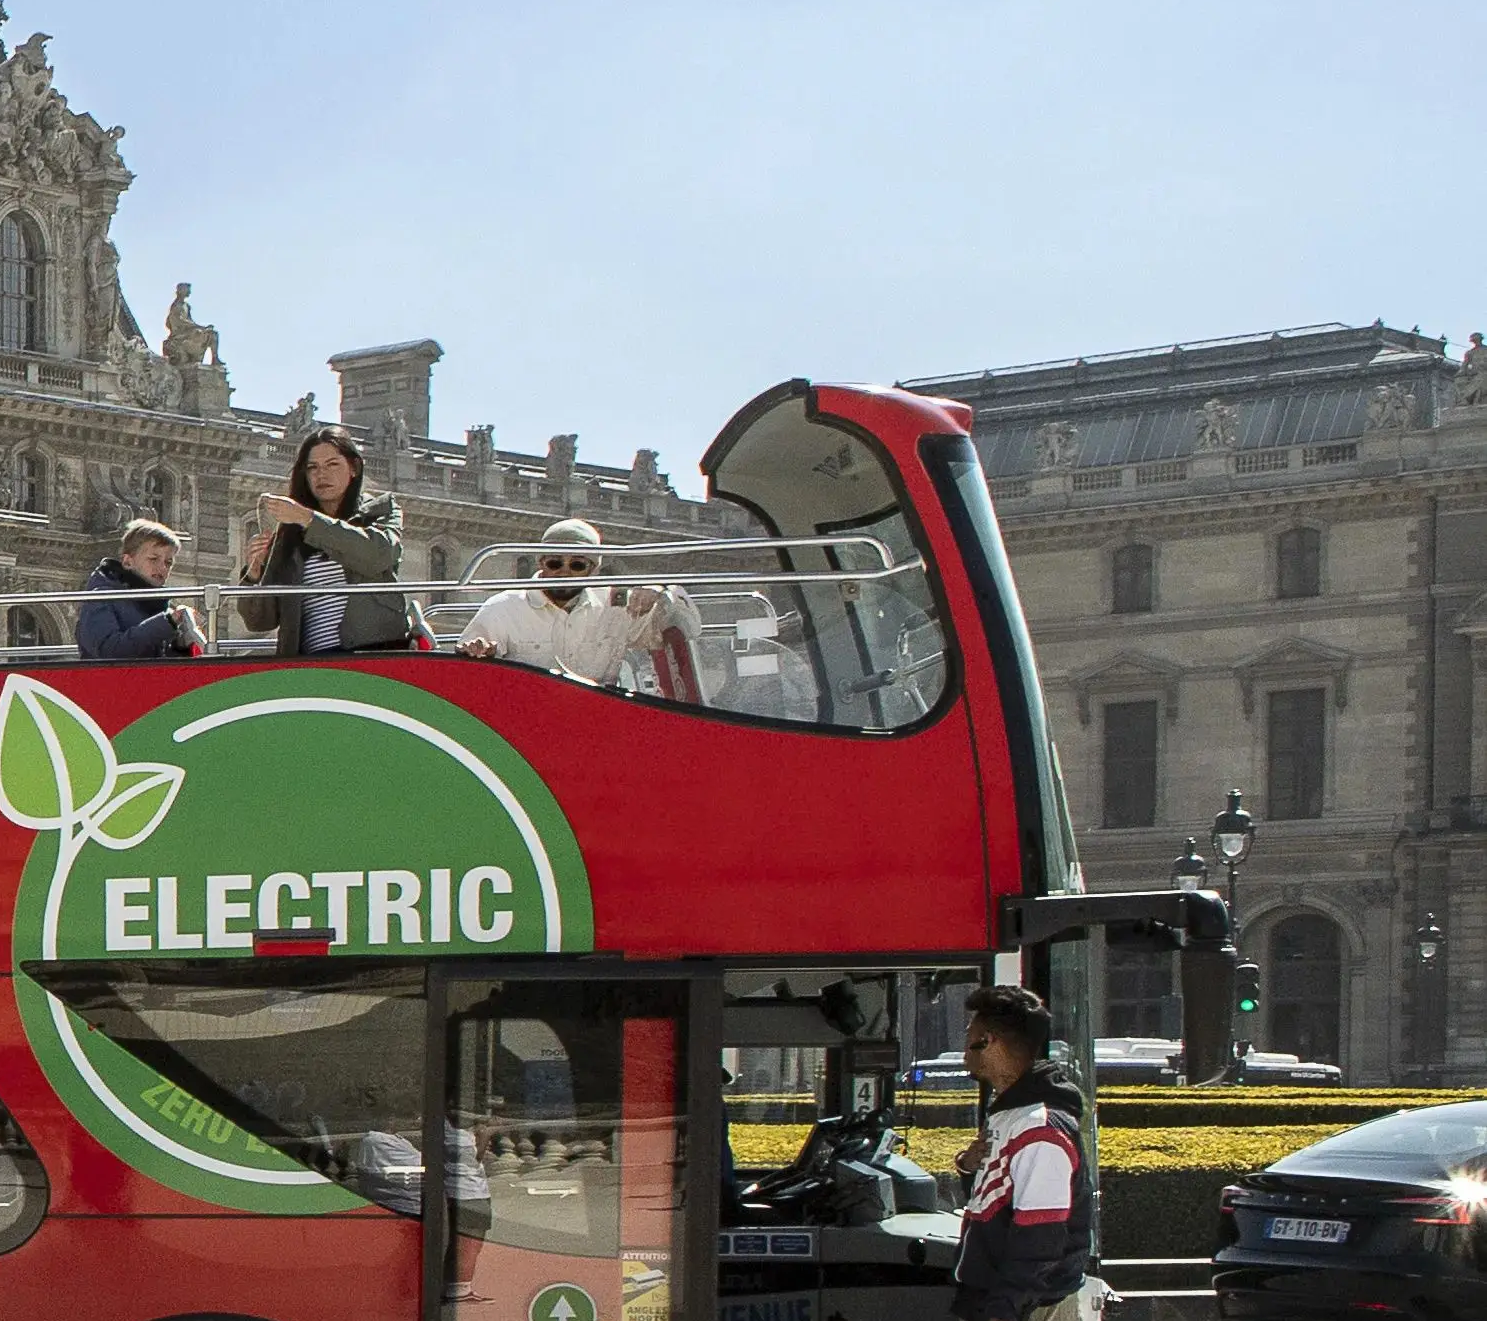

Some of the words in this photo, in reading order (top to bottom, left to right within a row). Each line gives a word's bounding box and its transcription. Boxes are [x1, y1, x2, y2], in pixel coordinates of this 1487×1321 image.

[104, 865, 515, 951] ELECTRIC
[858, 1082, 871, 1102] 4
[622, 1252, 672, 1261] ATTENTIO
[627, 1305, 670, 1315] ANGLES
